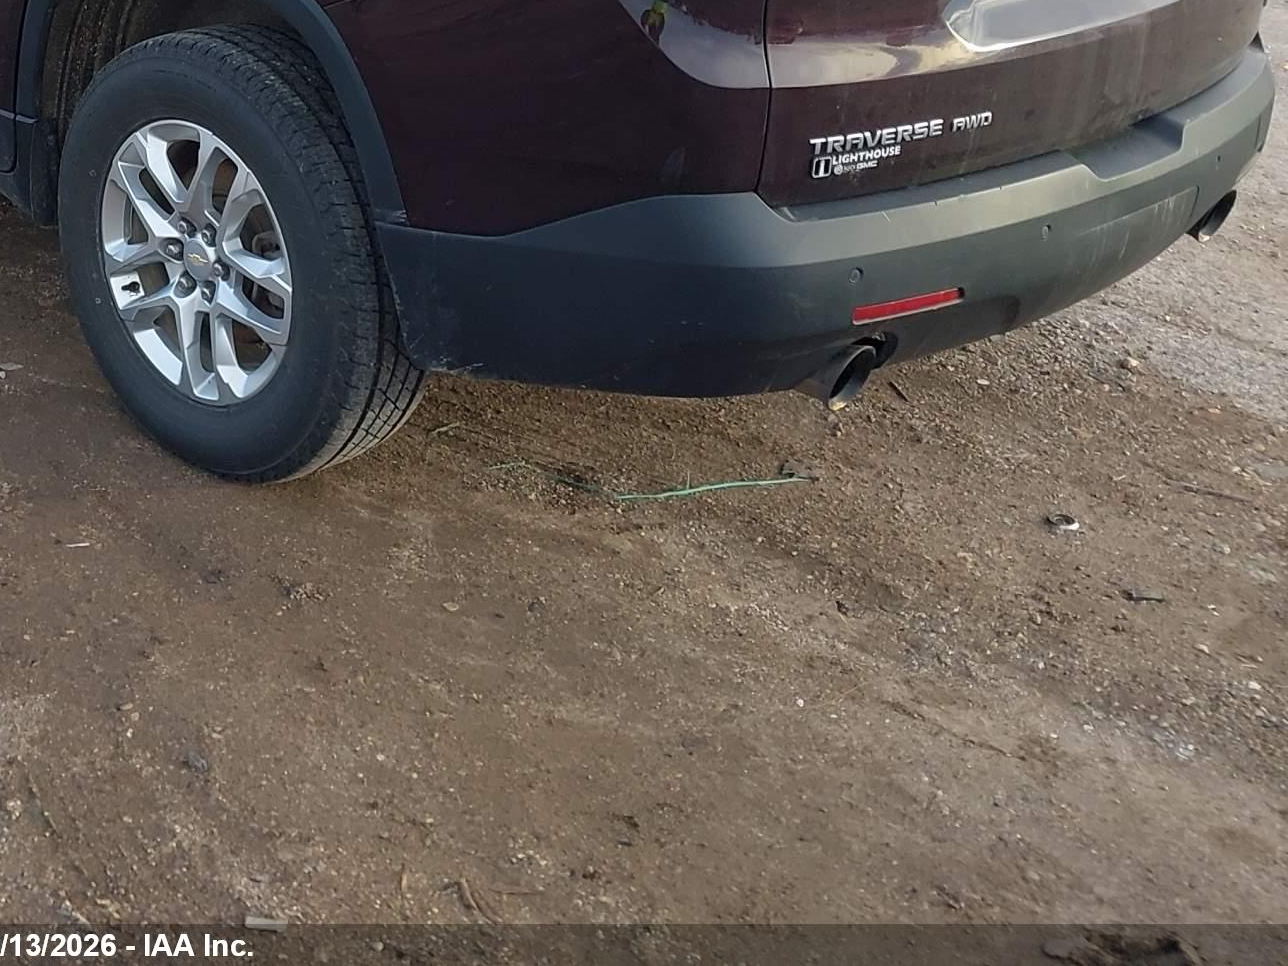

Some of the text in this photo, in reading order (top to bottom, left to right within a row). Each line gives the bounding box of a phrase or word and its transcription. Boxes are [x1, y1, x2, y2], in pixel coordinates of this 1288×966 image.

[809, 111, 993, 155] TRAVERSE AWD
[832, 145, 902, 166] LIGHTHOUSE
